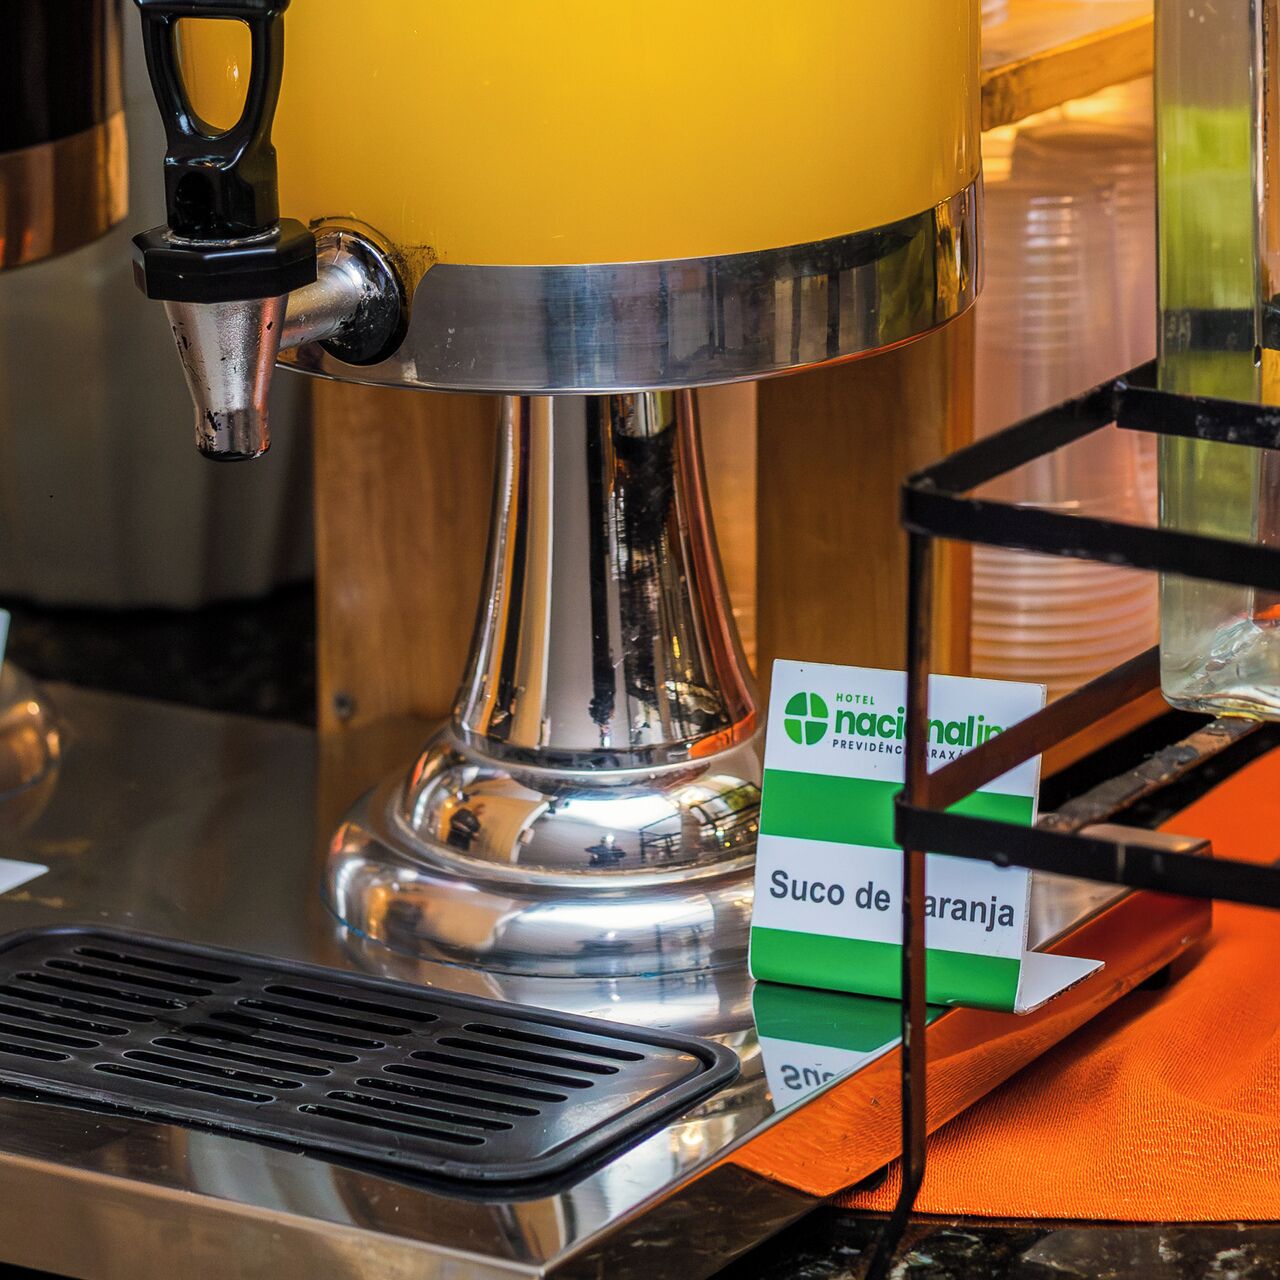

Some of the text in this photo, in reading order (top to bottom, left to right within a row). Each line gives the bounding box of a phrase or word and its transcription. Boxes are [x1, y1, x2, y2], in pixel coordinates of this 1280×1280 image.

[836, 693, 875, 706] HOTEL
[835, 706, 1009, 747] nacinalin
[832, 738, 903, 755] PREVIDÊNC
[770, 869, 1015, 932] Suco de aranja
